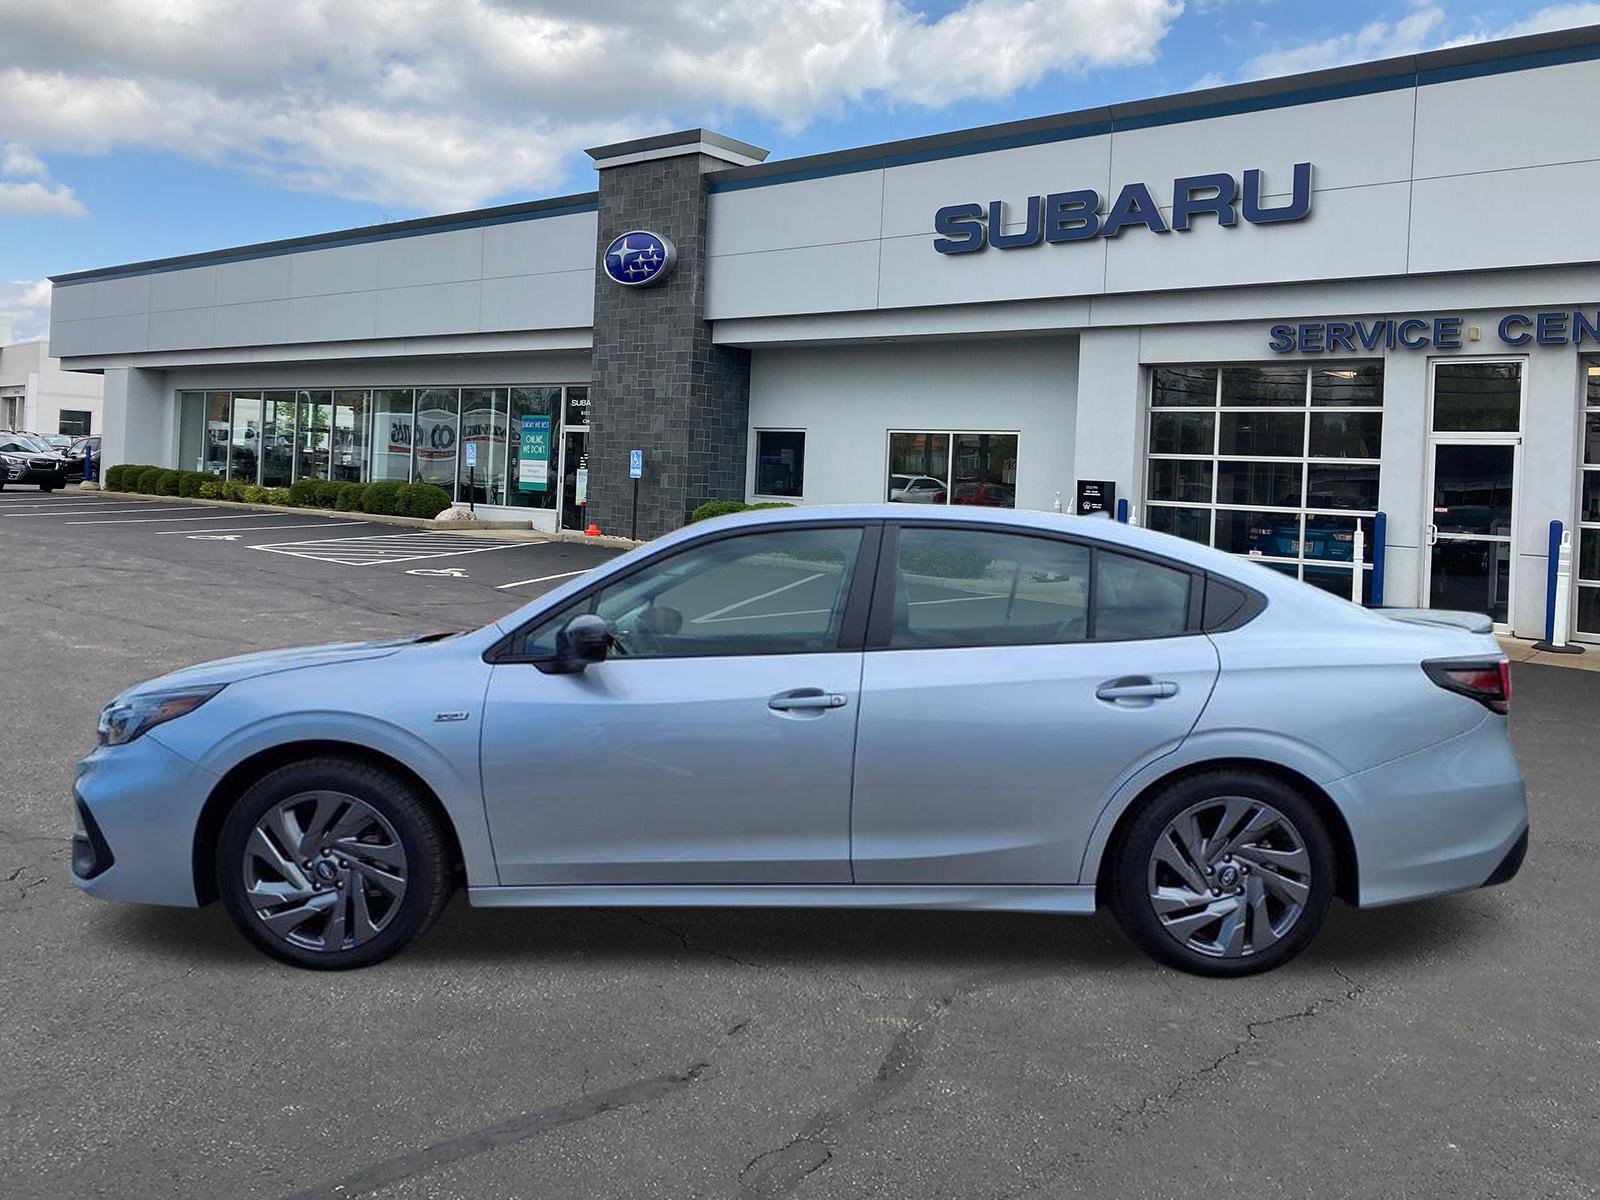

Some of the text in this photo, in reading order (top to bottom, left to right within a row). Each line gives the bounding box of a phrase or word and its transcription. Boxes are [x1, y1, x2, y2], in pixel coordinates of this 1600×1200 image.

[934, 162, 1313, 254] SUBARU
[1269, 311, 1600, 352] SERVICE CEN
